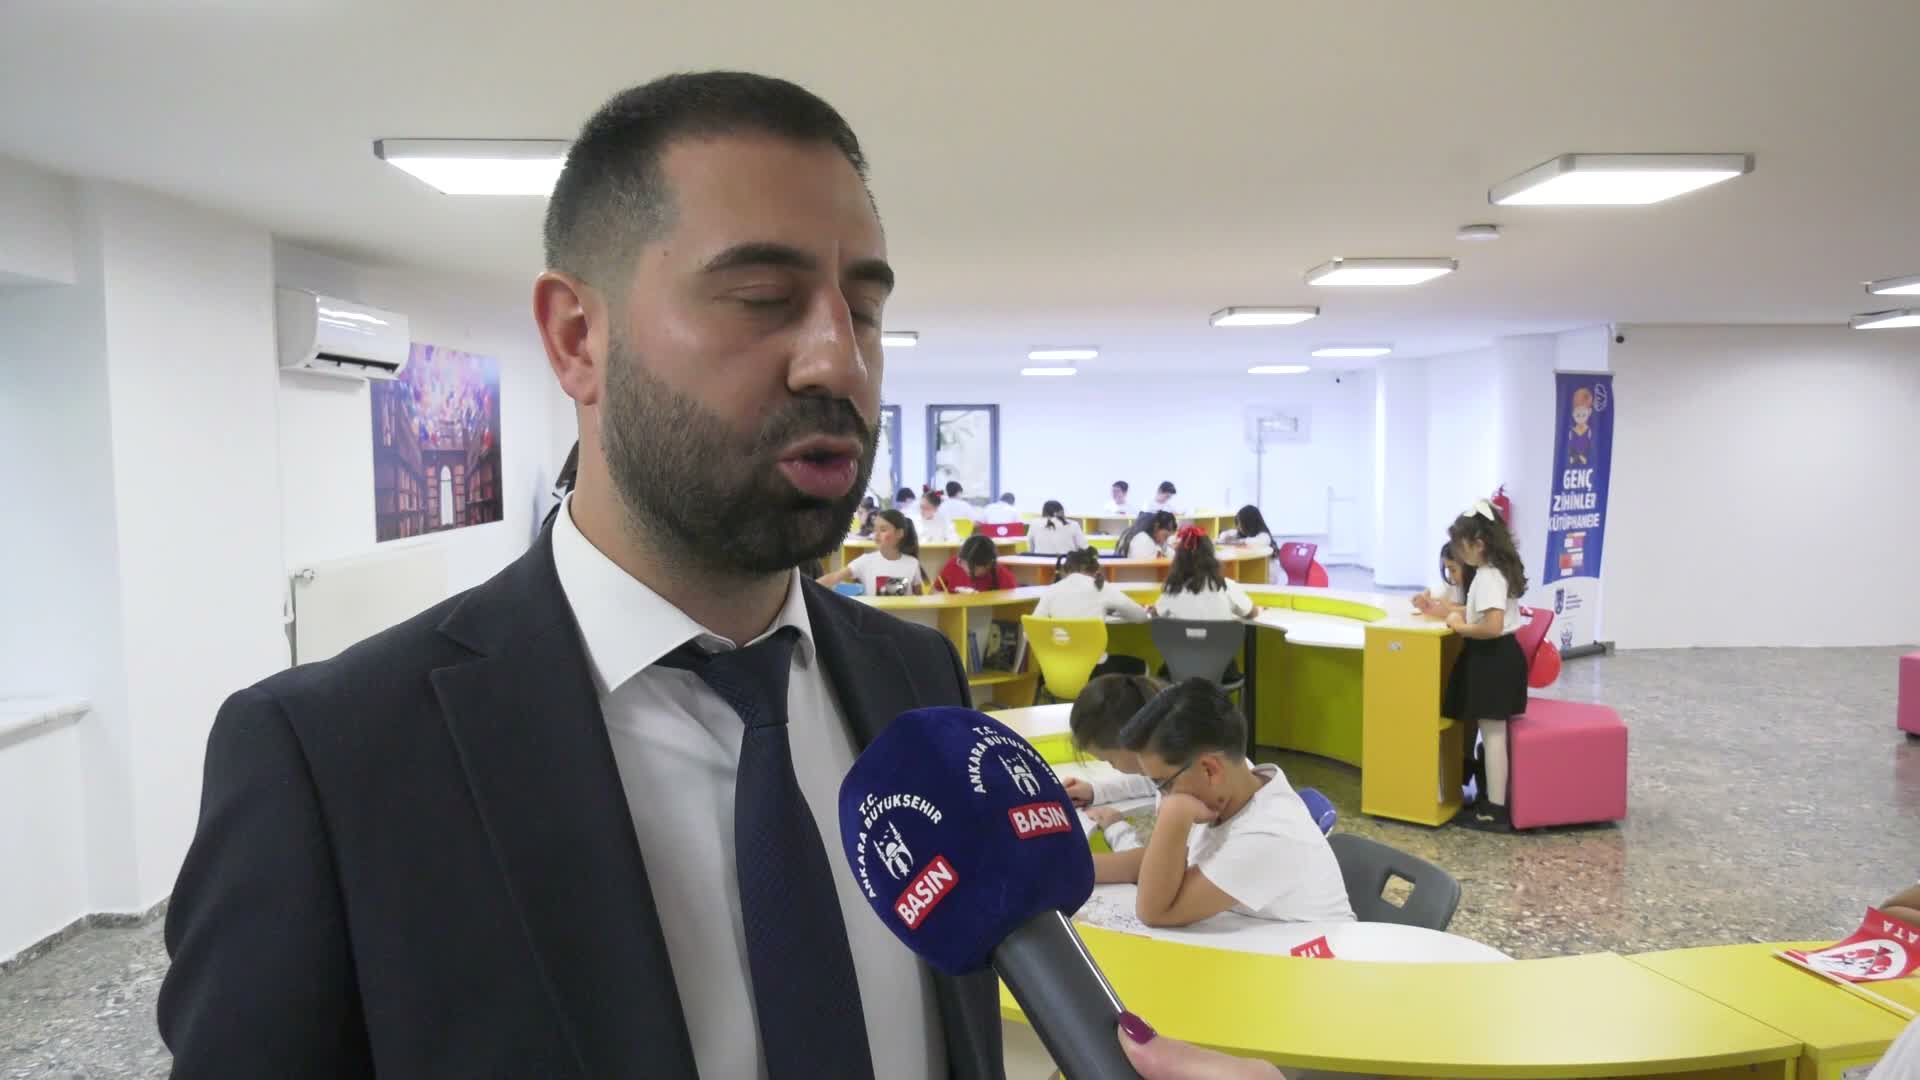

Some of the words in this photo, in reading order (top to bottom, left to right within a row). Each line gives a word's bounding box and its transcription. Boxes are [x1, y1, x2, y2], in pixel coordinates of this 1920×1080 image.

[1563, 468, 1593, 491] GENÇ
[967, 742, 988, 794] ANKARA
[1012, 806, 1070, 834] BASIN
[857, 832, 877, 898] ANKARA
[897, 861, 953, 926] BASIN
